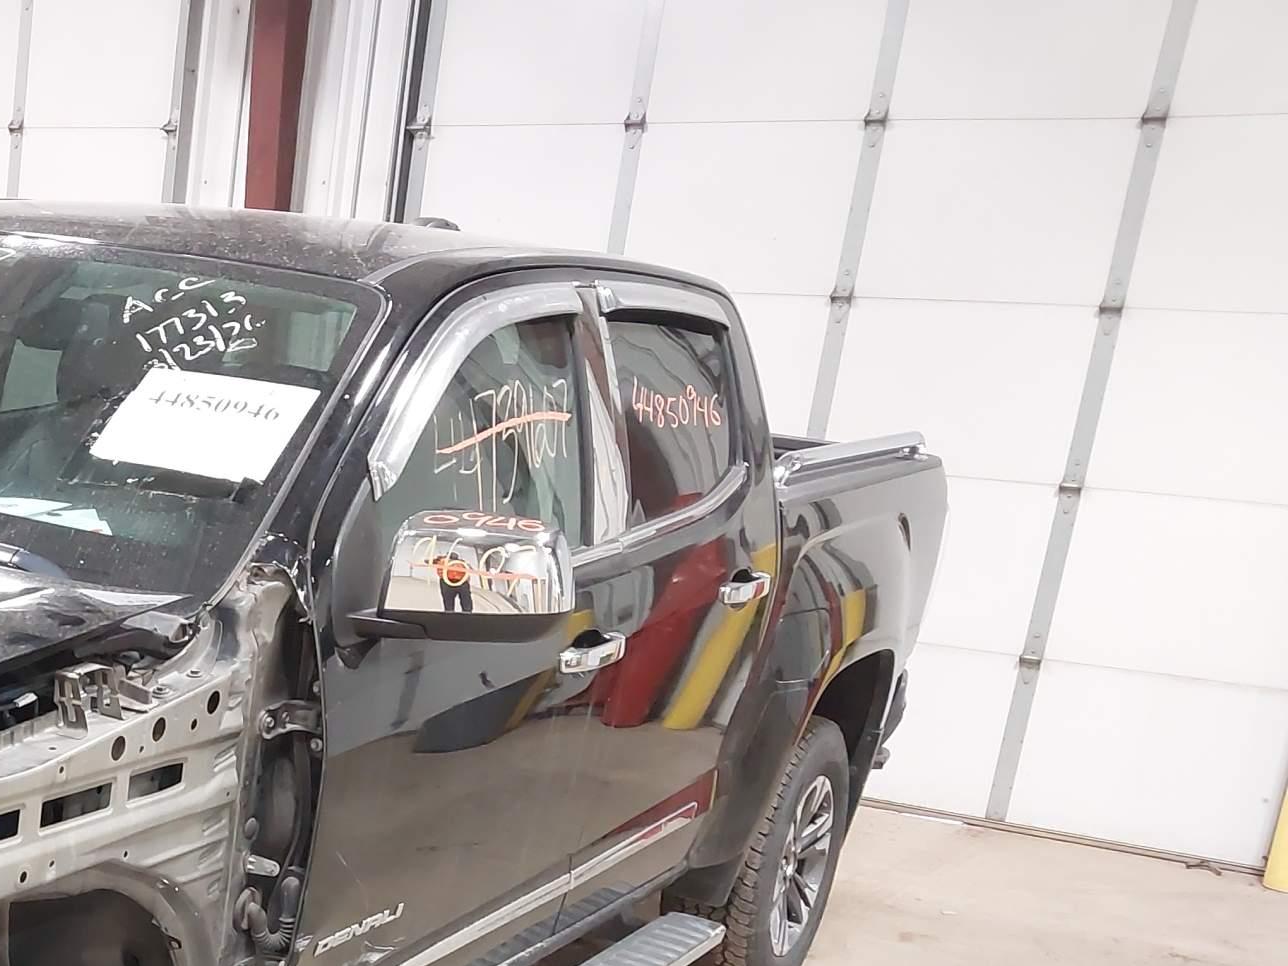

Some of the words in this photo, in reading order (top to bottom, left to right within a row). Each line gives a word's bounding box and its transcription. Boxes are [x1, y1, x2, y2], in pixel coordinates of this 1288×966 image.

[632, 376, 721, 428] 44850946
[423, 512, 546, 532] 0946
[313, 903, 404, 957] DENALI
